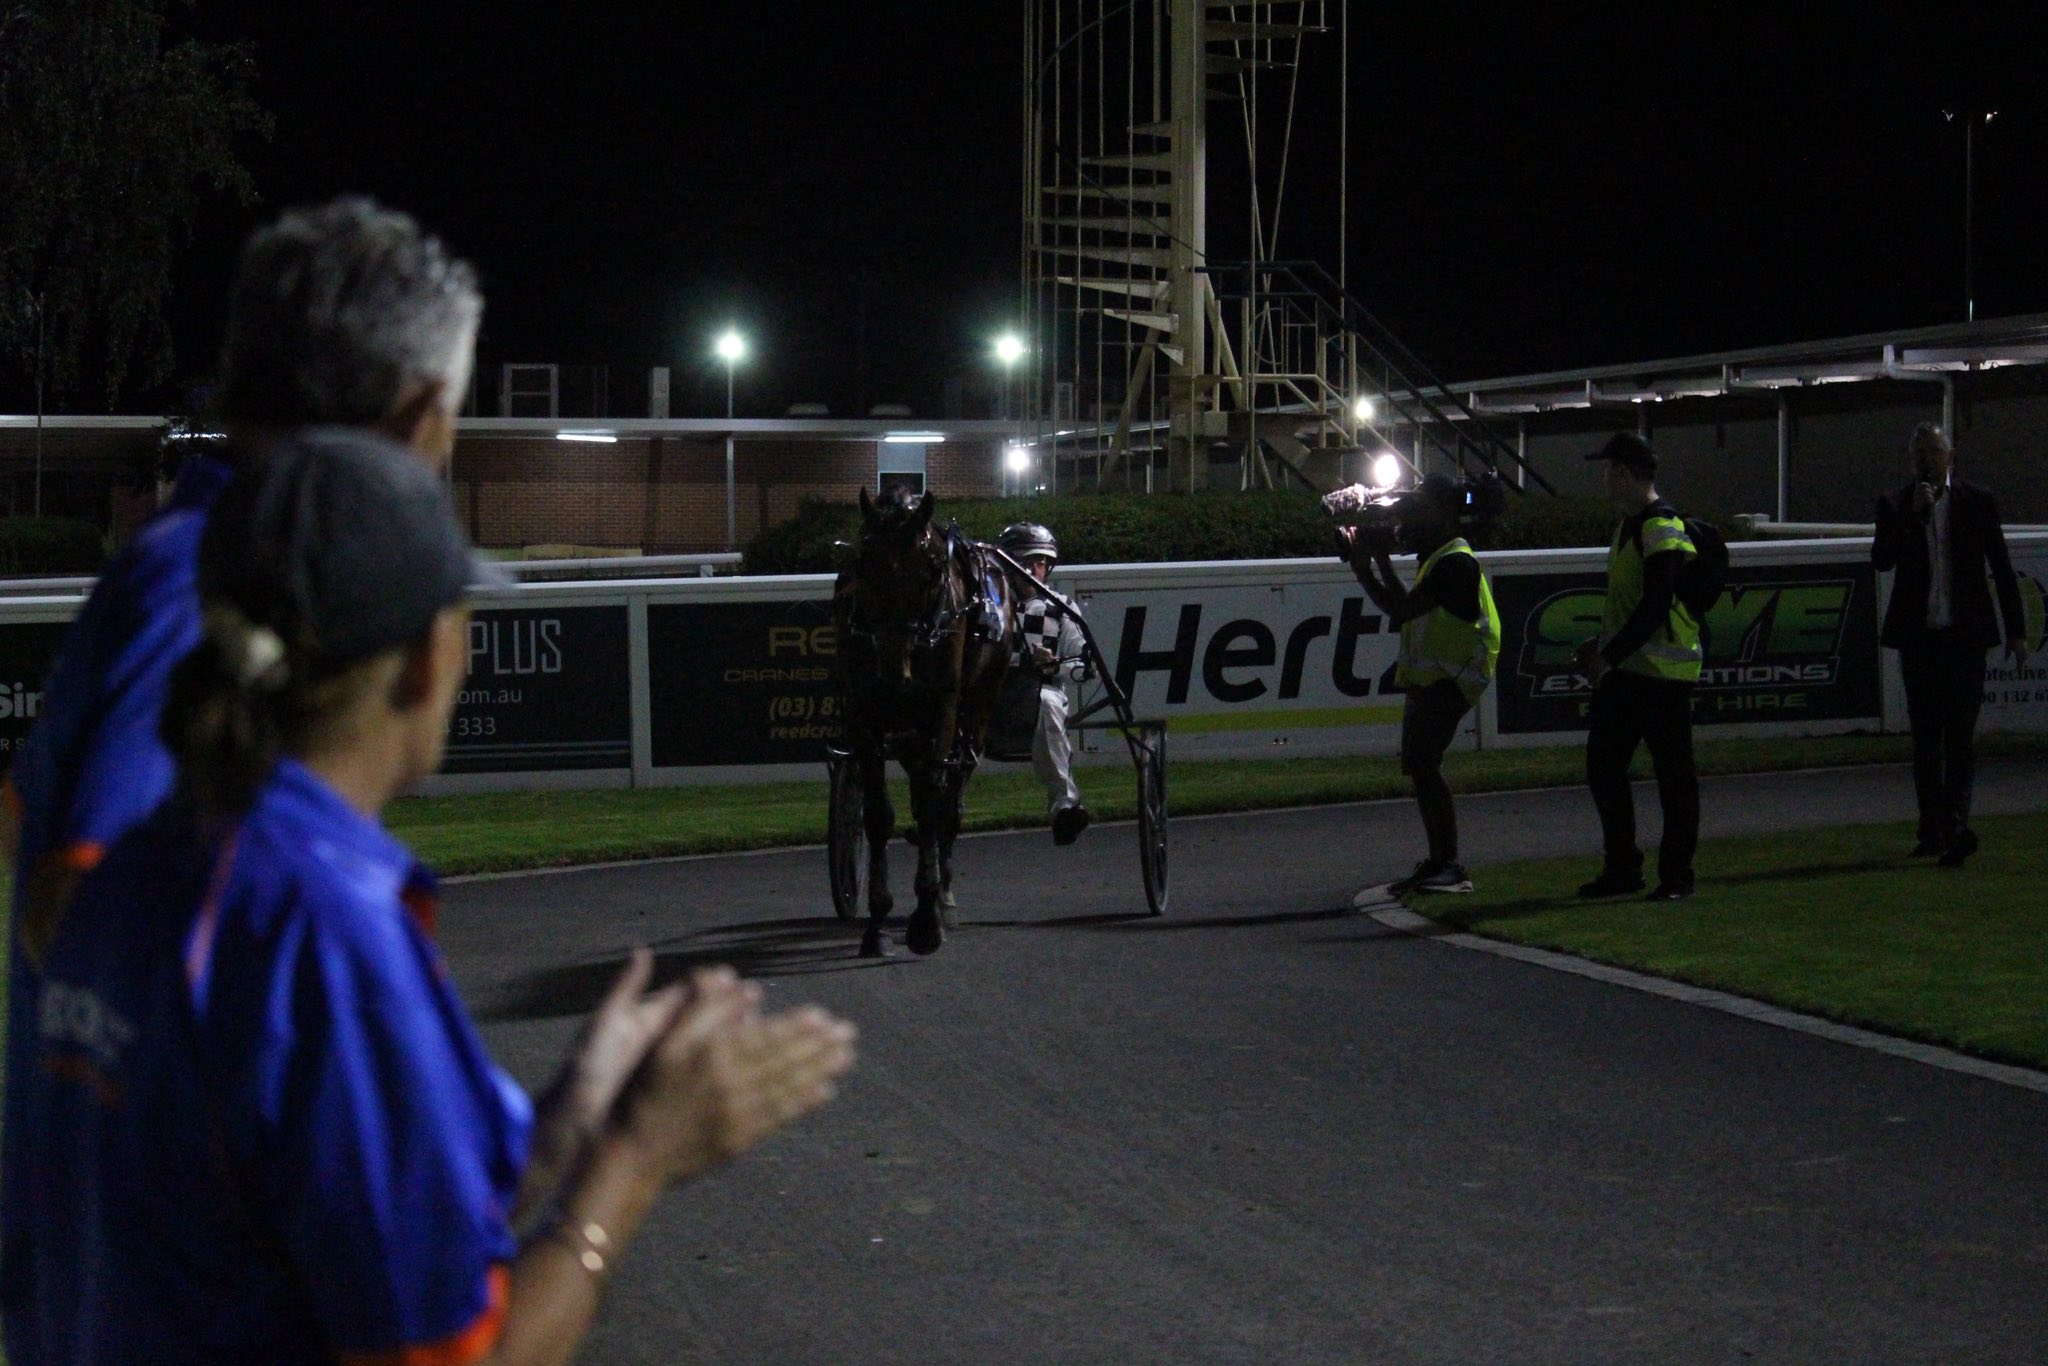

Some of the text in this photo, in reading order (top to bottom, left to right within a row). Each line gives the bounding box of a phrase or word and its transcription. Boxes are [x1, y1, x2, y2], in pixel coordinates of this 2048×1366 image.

[466, 619, 562, 675] PLUS
[724, 668, 829, 682] CRANES
[769, 696, 816, 721] (03)
[1717, 692, 1808, 711] HIRE
